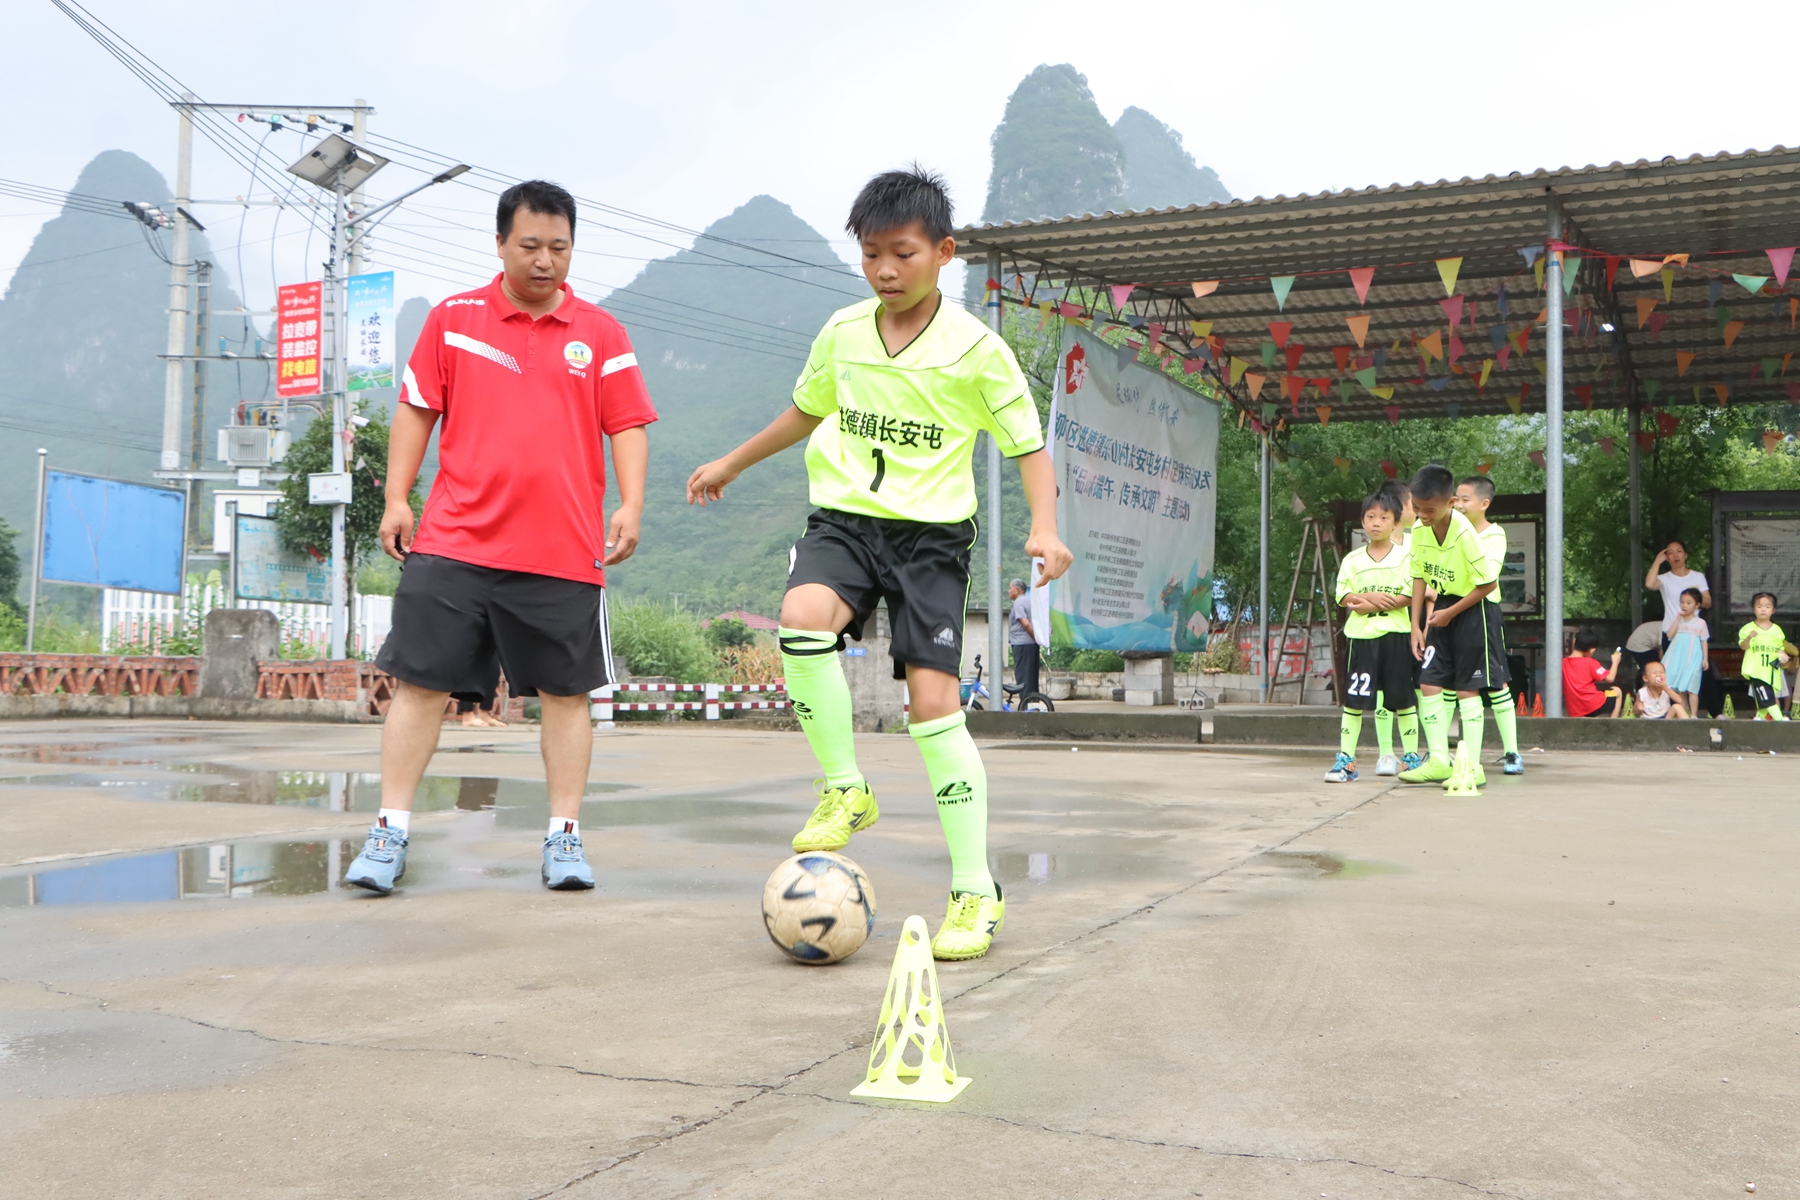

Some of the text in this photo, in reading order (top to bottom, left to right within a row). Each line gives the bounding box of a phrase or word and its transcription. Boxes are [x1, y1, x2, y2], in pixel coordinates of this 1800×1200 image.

[282, 320, 318, 340] 拉宽带
[367, 311, 382, 364] 欢迎您
[281, 339, 318, 359] 装监控
[281, 358, 317, 378] 找电信
[869, 447, 886, 493] 1
[1760, 653, 1770, 667] 11
[1347, 671, 1371, 697] 22
